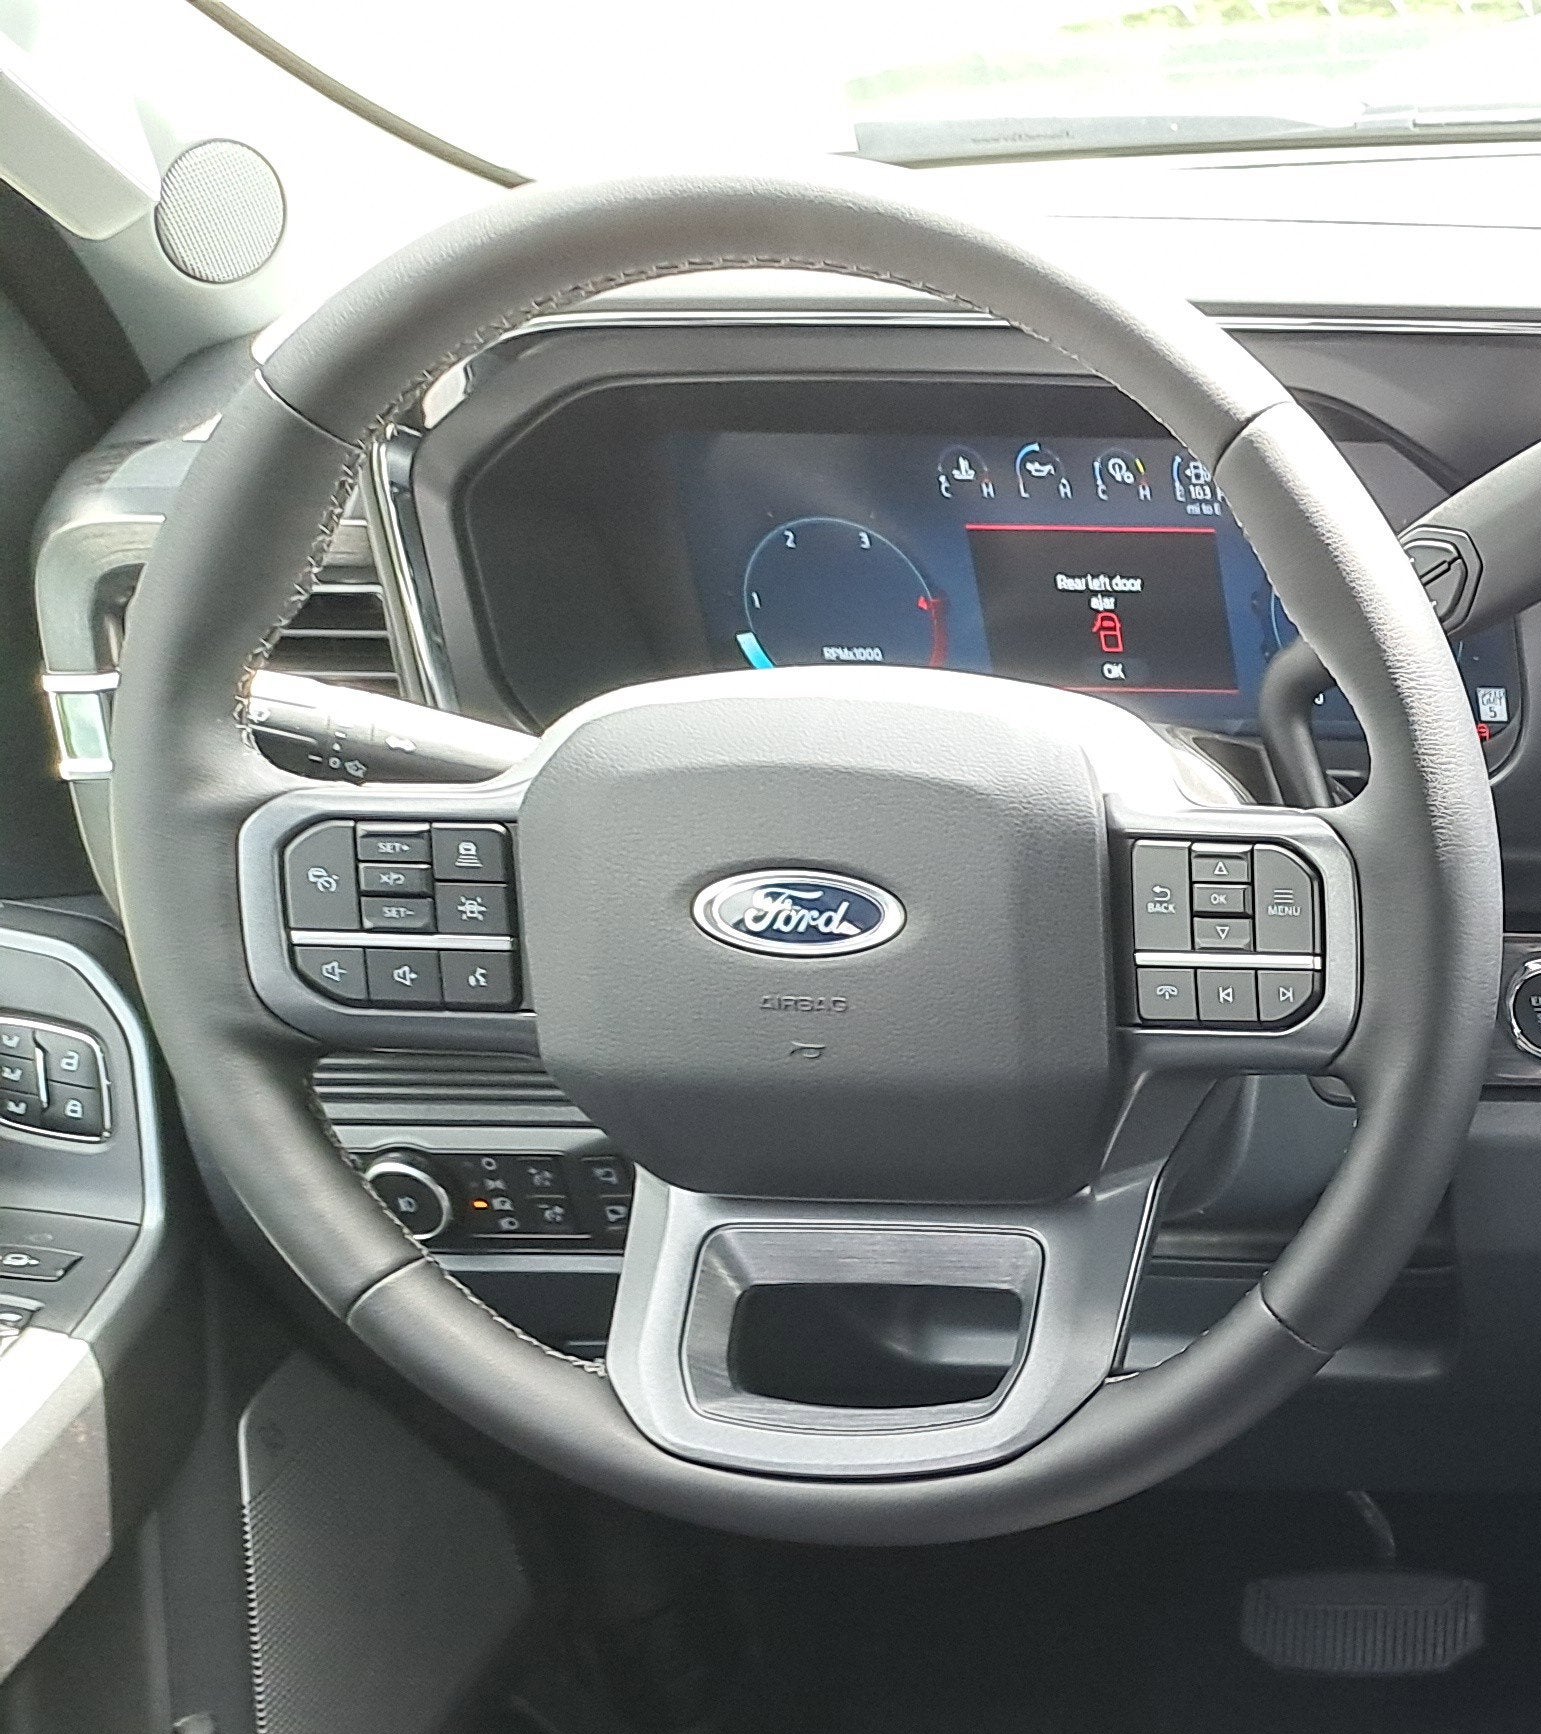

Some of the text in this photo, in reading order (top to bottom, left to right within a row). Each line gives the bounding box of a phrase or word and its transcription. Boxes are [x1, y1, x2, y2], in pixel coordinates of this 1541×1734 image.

[783, 530, 797, 549] 2
[858, 531, 872, 550] 3
[1055, 573, 1142, 592] Rear left door
[1147, 902, 1176, 914] BACK
[1210, 893, 1228, 905] OK
[746, 884, 862, 935] Ford
[1267, 905, 1301, 917] MENU
[760, 995, 848, 1014] AIRBAG
